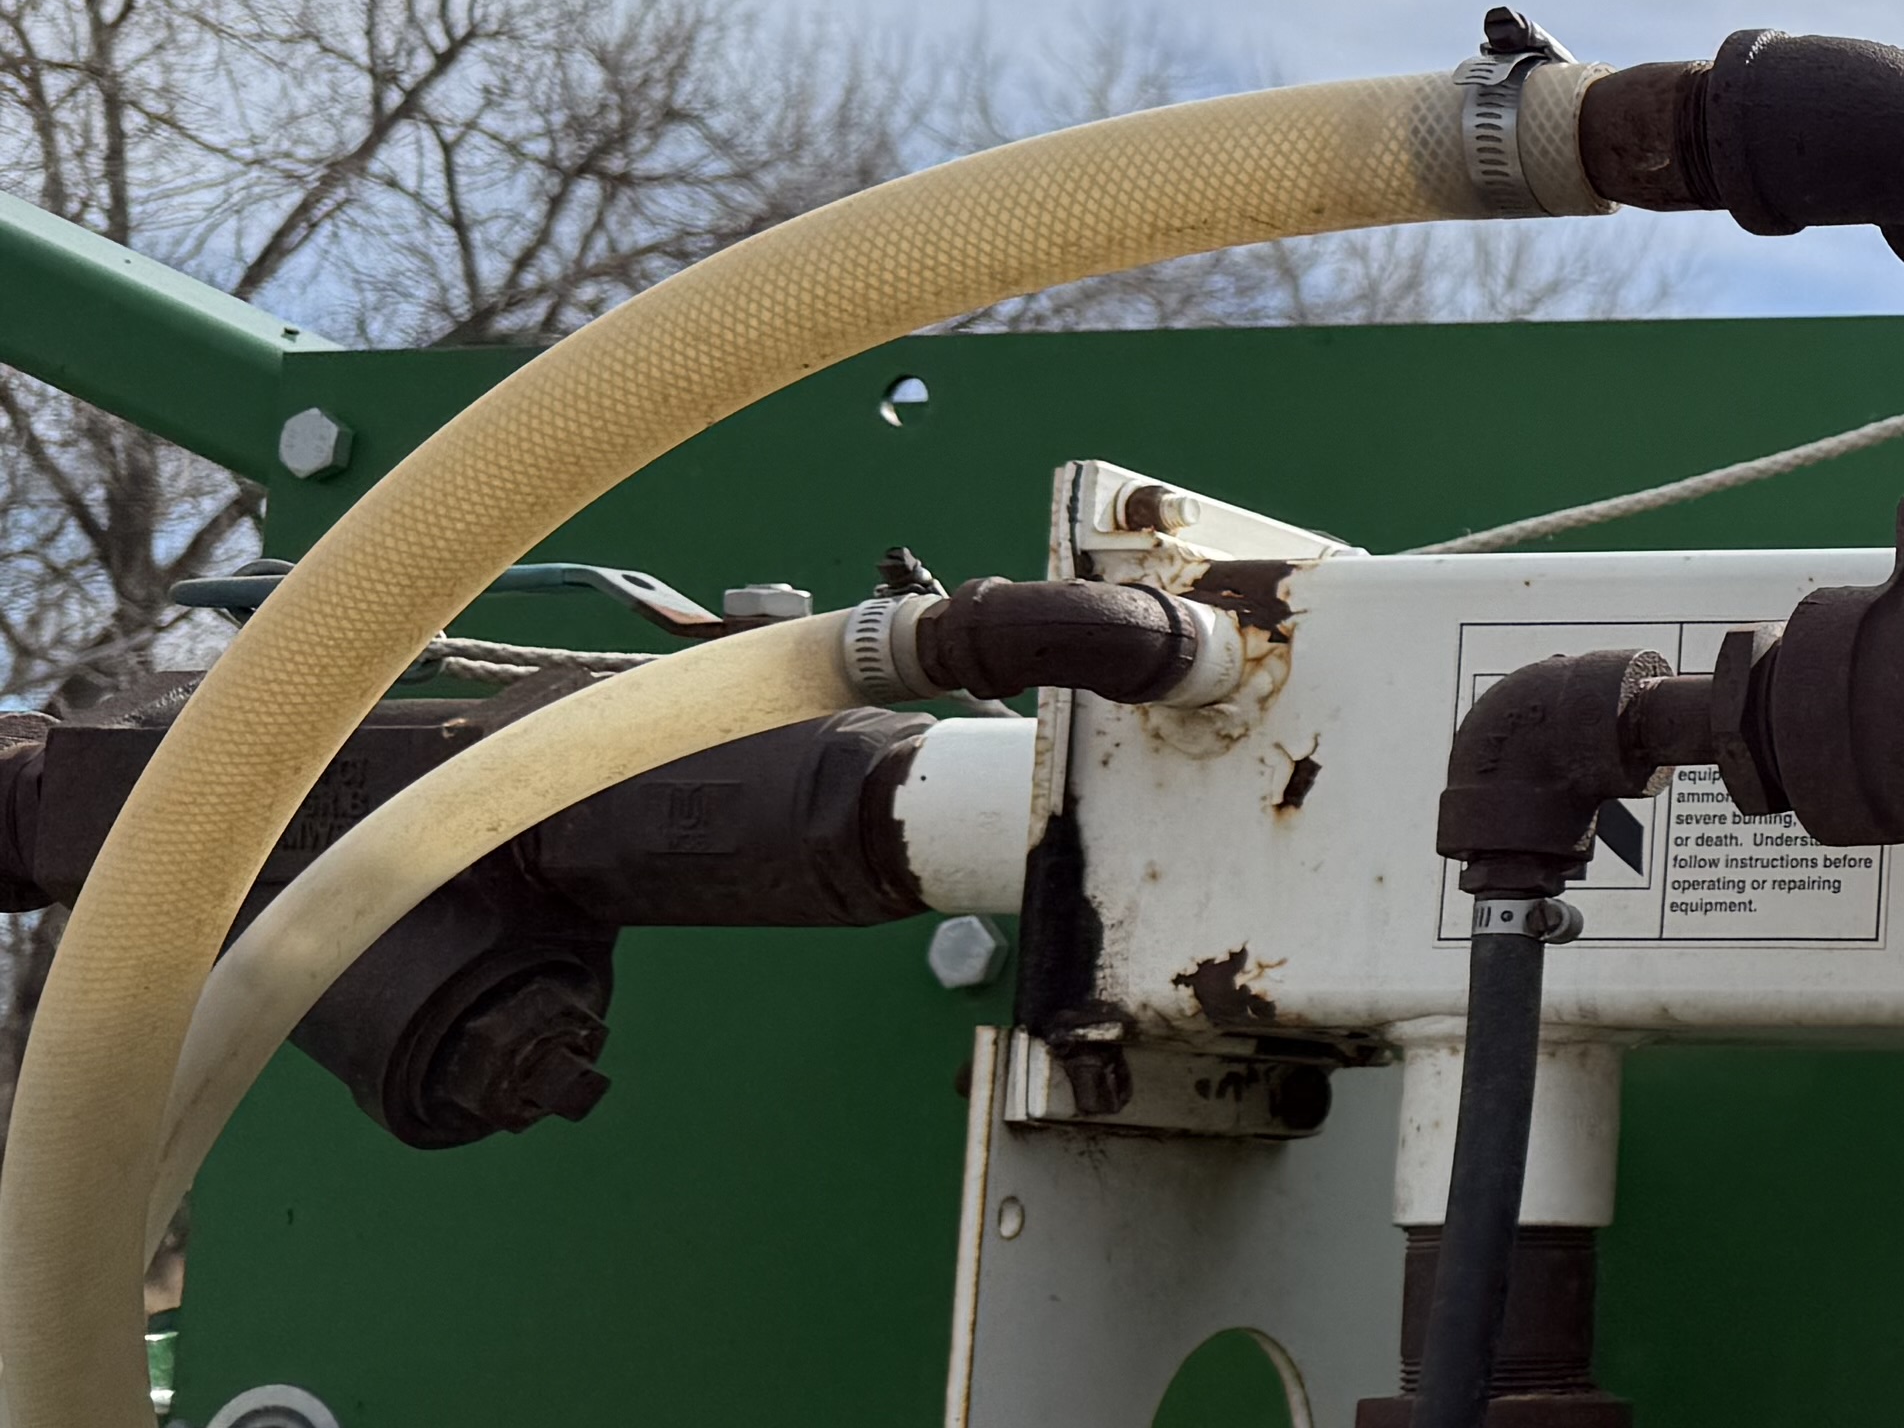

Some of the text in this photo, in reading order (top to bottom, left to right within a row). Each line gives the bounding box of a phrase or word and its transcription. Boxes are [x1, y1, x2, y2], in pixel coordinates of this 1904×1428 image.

[1676, 812, 1727, 825] severe
[1674, 833, 1743, 847] or death.
[1673, 854, 1873, 868] follow instructions before
[1672, 876, 1841, 893] operating or repairing
[1670, 898, 1757, 915] equipment.
